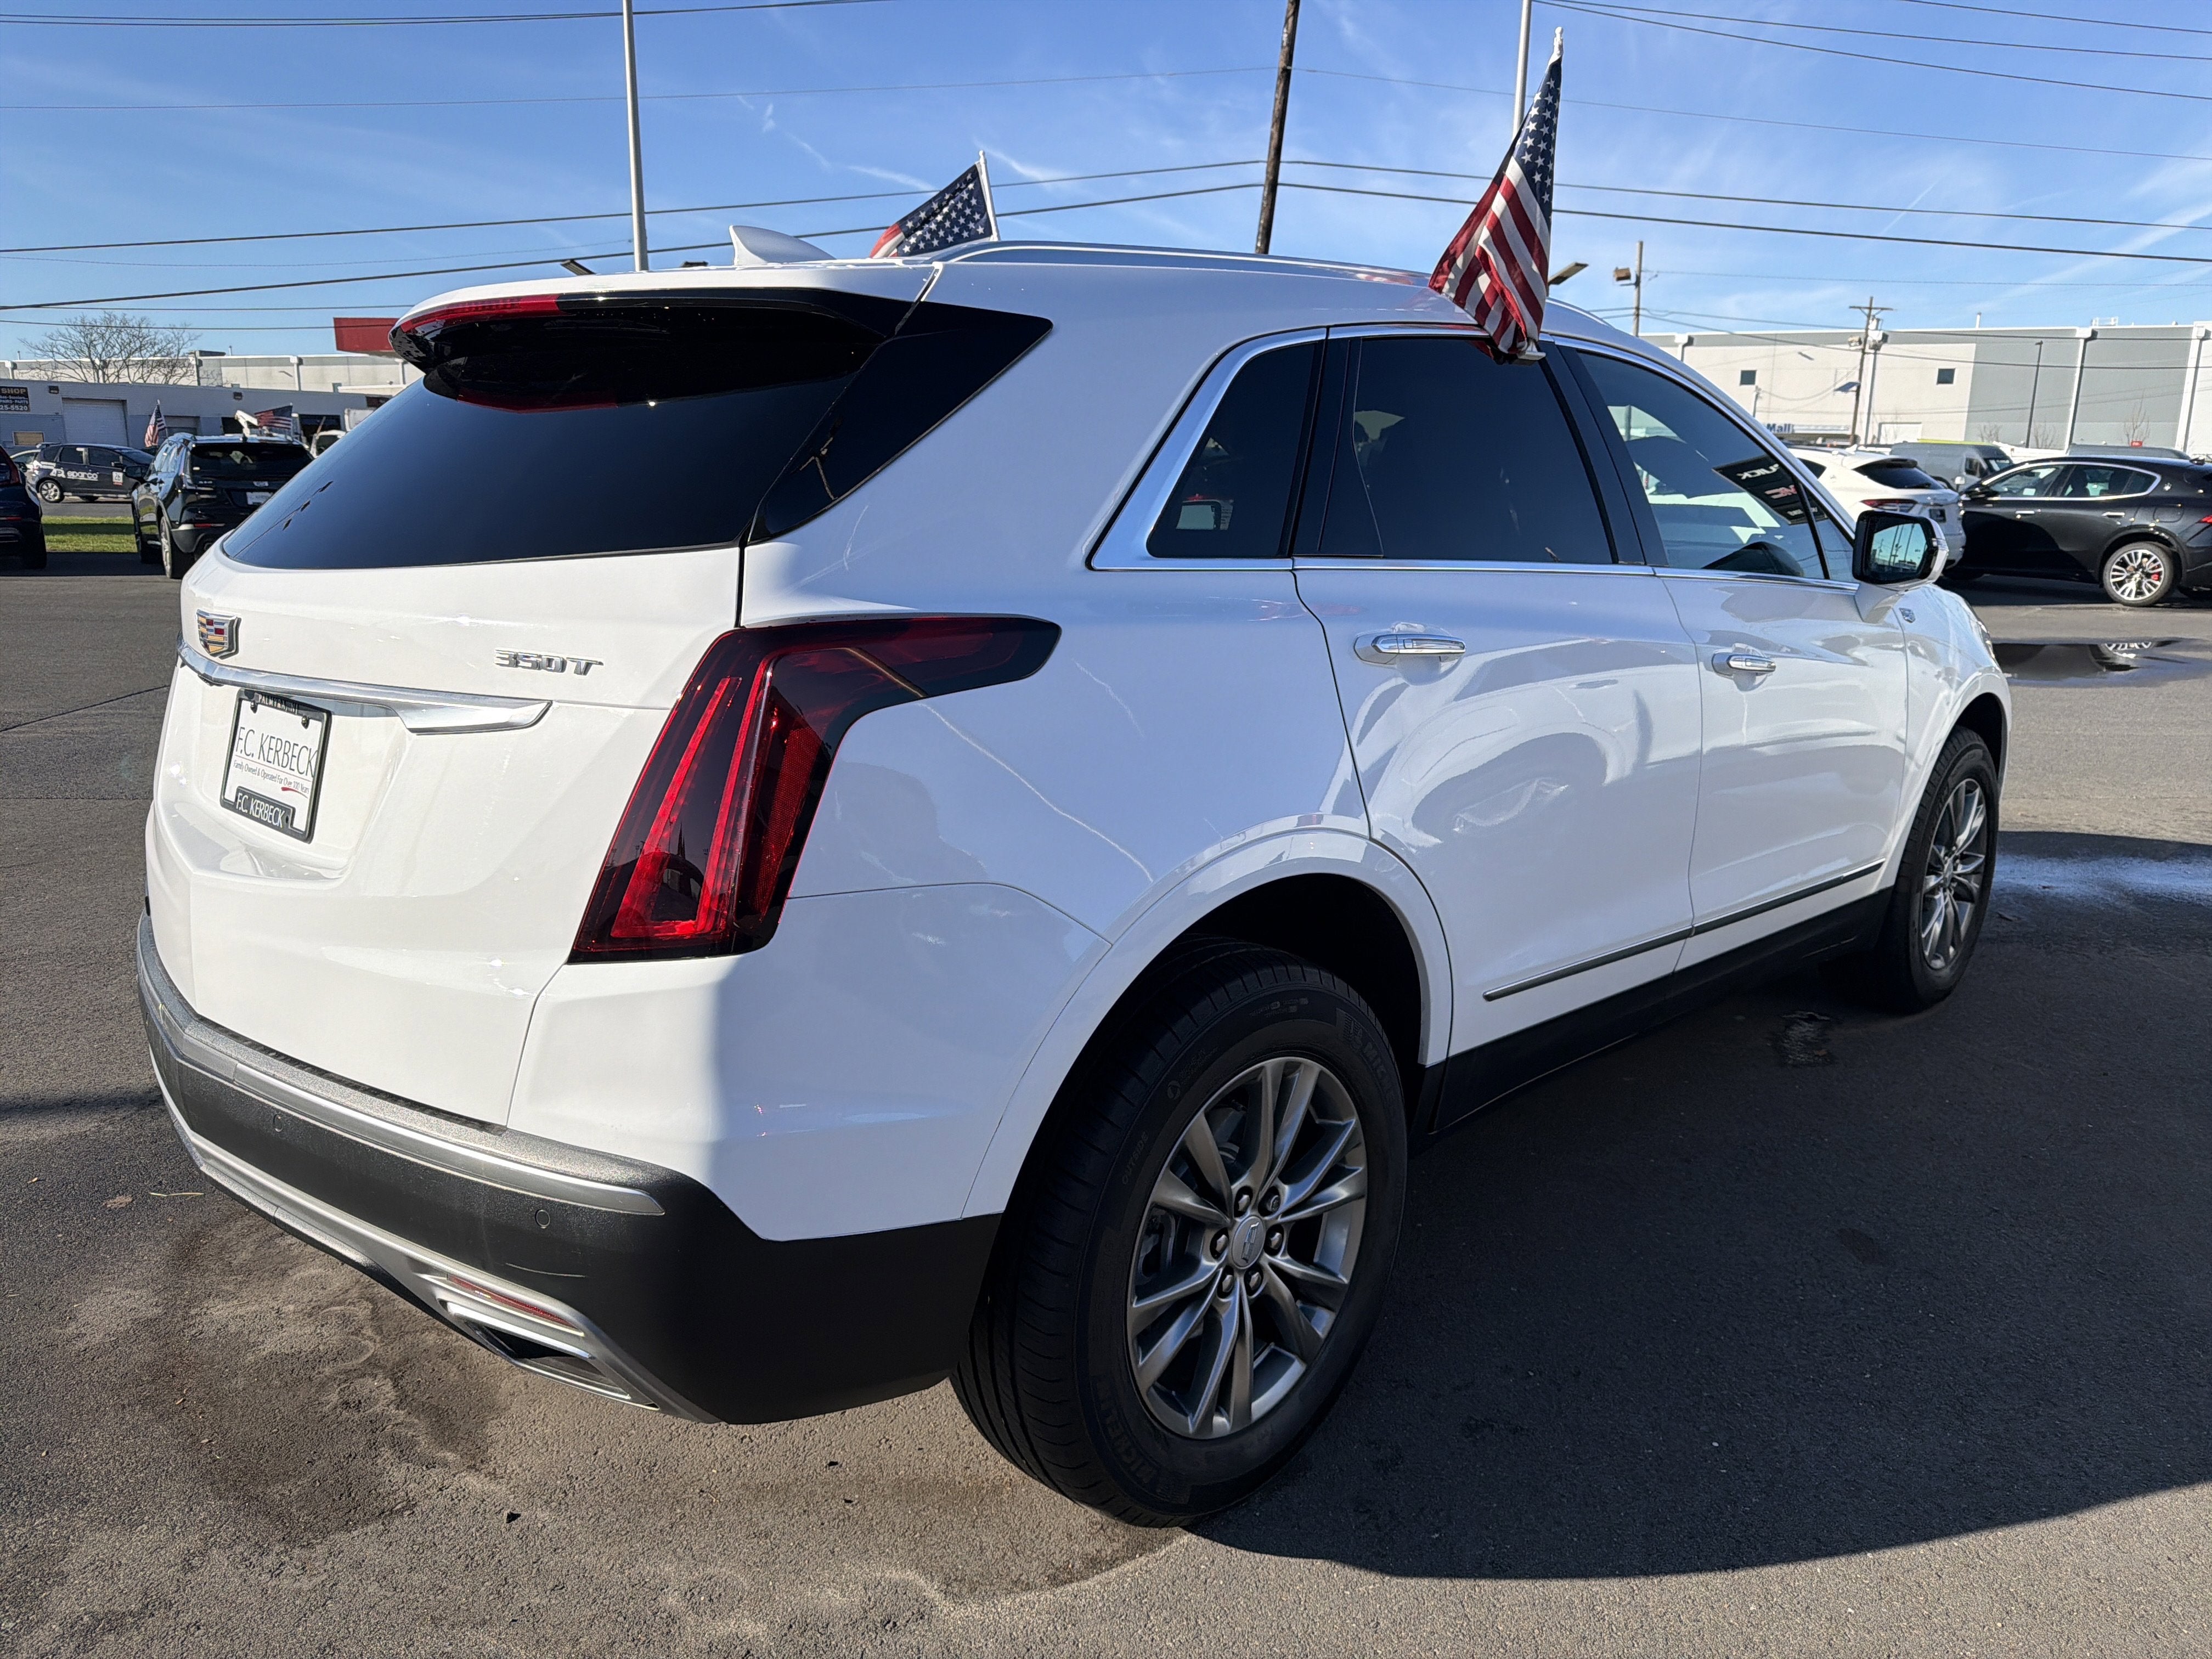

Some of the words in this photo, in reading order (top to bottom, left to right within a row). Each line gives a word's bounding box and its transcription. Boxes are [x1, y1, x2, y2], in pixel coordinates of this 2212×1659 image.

[236, 726, 255, 758] F.C.
[258, 732, 318, 778] KERBECK
[245, 763, 257, 775] Owned
[261, 769, 277, 782] Operated
[284, 777, 293, 787] Over
[236, 792, 249, 813] F.C.
[249, 798, 285, 828] KERBECK
